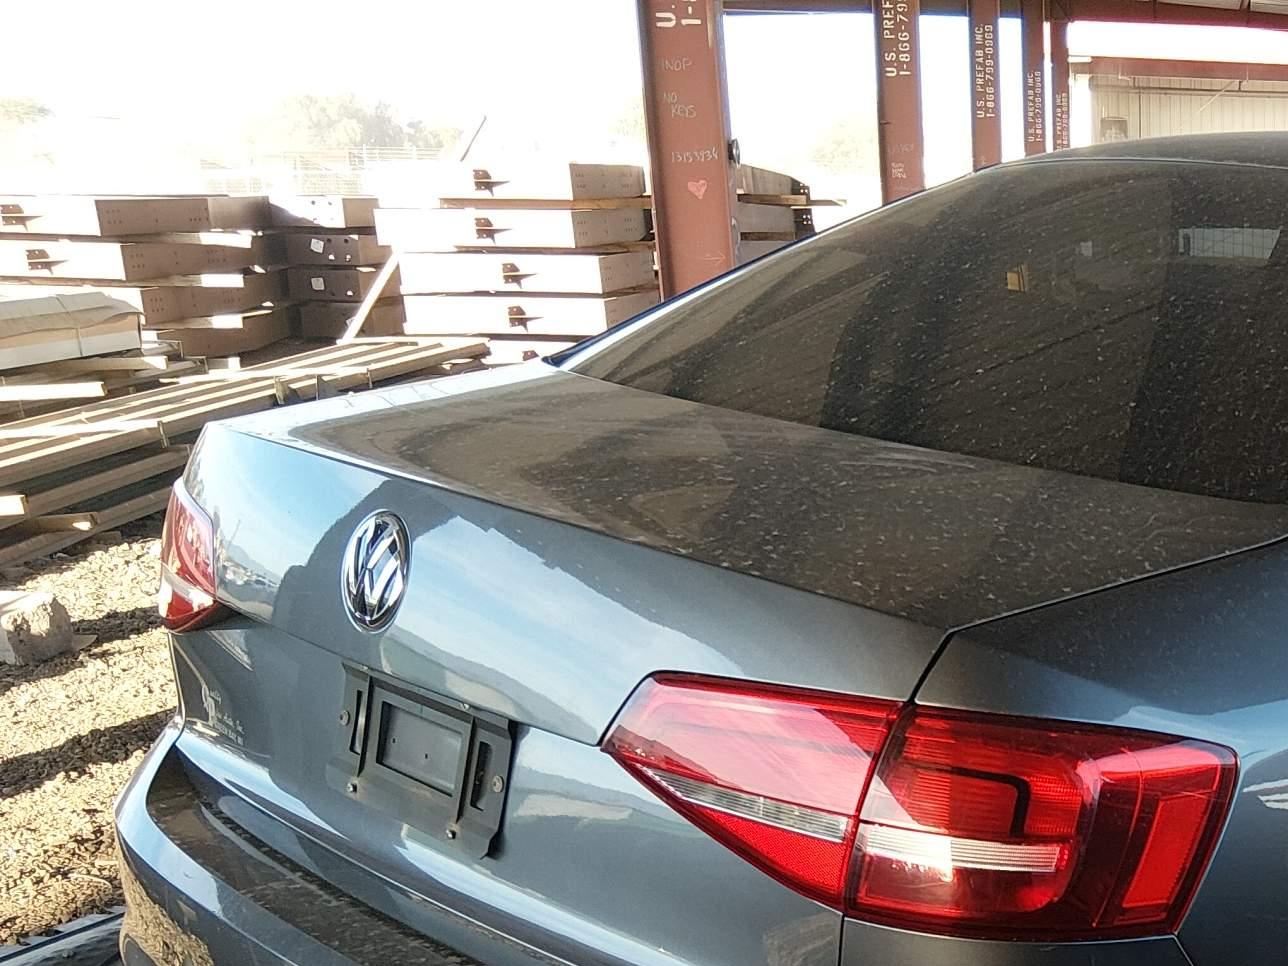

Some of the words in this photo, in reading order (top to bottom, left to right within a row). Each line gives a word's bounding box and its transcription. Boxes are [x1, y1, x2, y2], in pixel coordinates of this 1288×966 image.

[974, 23, 984, 45] INC.
[884, 47, 897, 77] U.S.
[975, 50, 985, 92] PREFAB
[663, 91, 679, 104] NO
[976, 97, 985, 118] U.S.
[671, 104, 697, 118] KEYS
